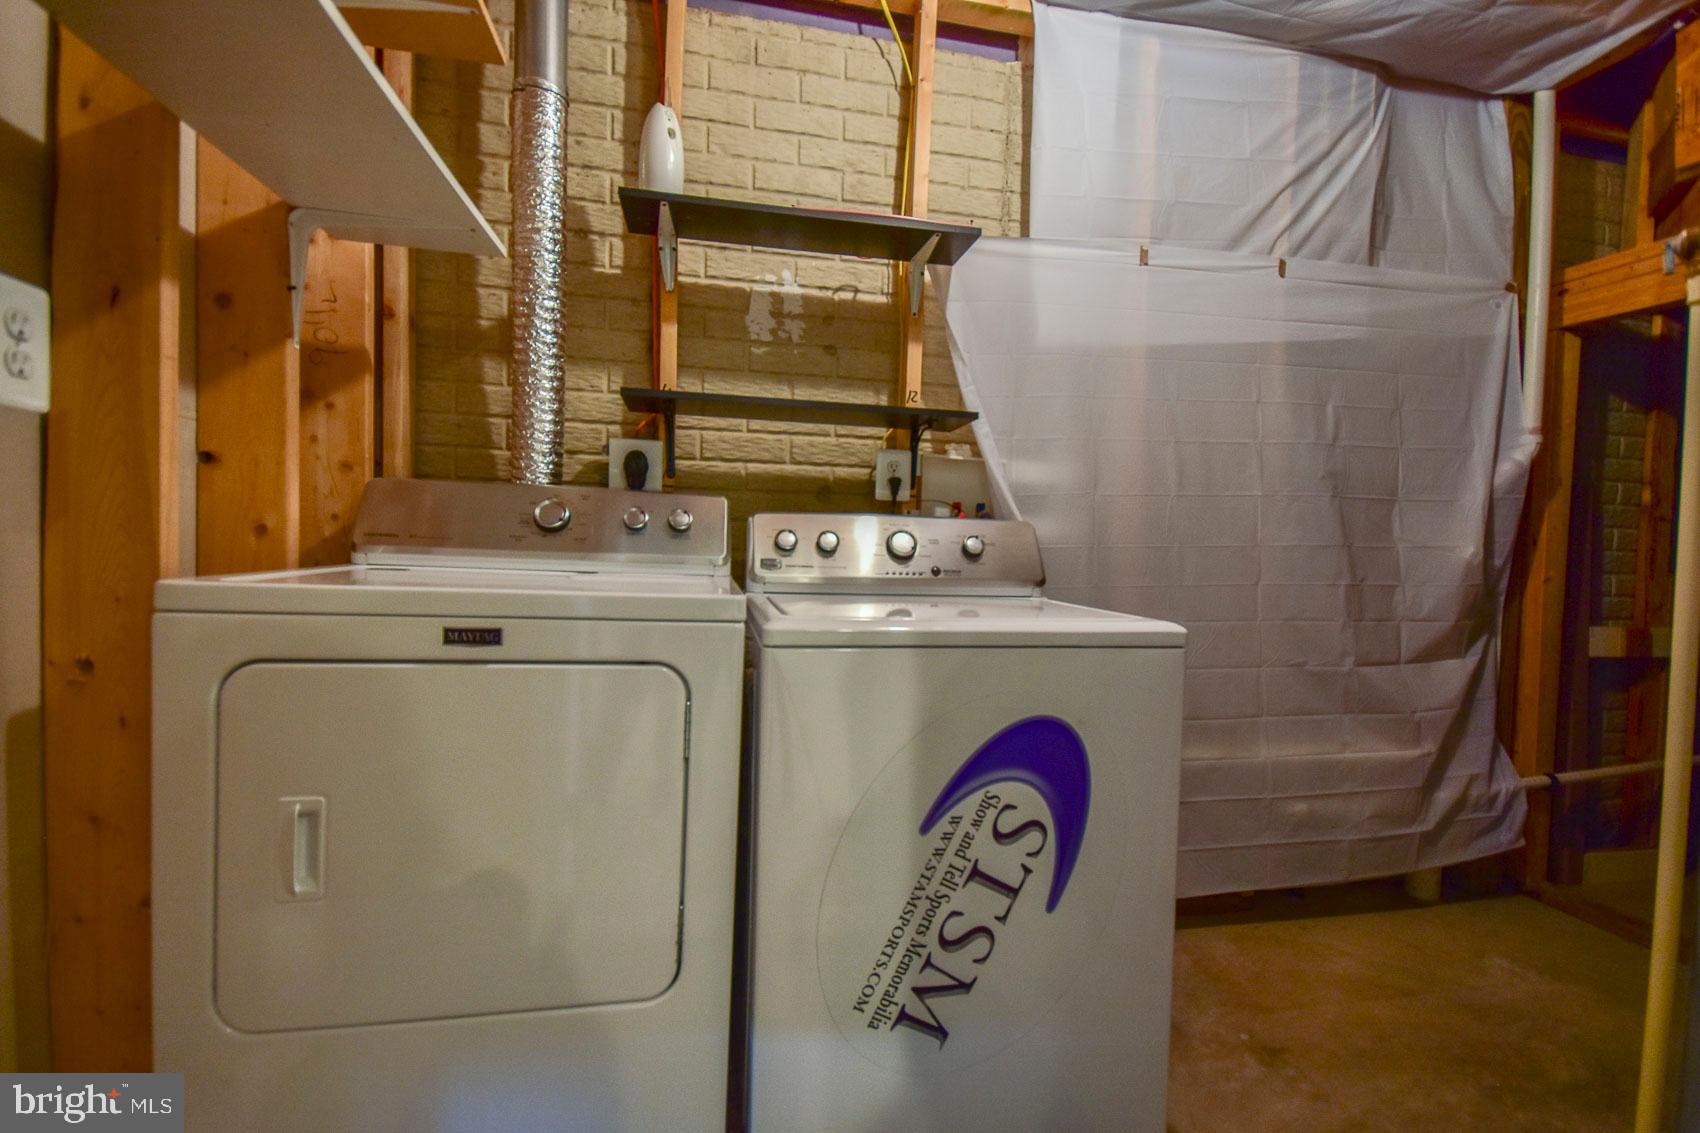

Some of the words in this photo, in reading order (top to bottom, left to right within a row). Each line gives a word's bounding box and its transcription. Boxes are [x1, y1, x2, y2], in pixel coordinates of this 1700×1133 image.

[447, 630, 501, 643] MAYTAG
[970, 790, 1001, 832] Show
[954, 831, 975, 863] and
[940, 863, 967, 892] Tell
[889, 803, 1048, 1051] STSM
[916, 889, 951, 937] Sports
[867, 936, 928, 1030] Memorabilia
